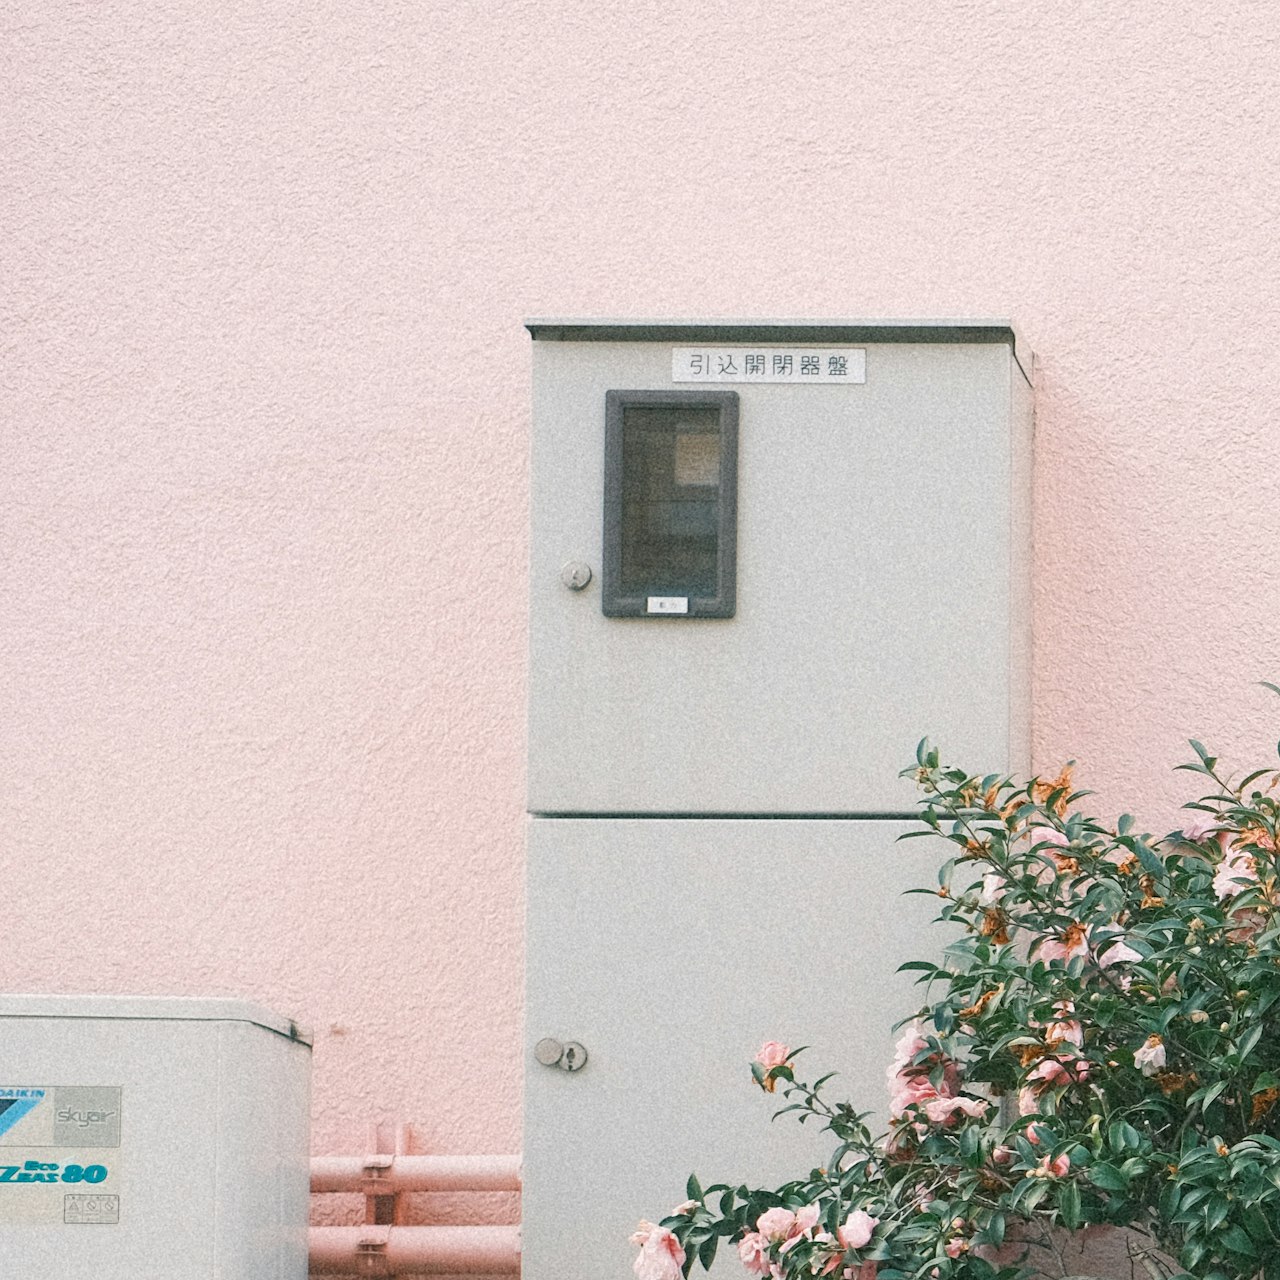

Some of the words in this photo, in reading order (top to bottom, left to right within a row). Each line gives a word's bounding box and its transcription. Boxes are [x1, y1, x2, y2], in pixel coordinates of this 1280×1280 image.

[690, 354, 848, 376] 引込開閉器盤
[58, 1106, 115, 1128] skyair
[61, 1164, 108, 1184] 80
